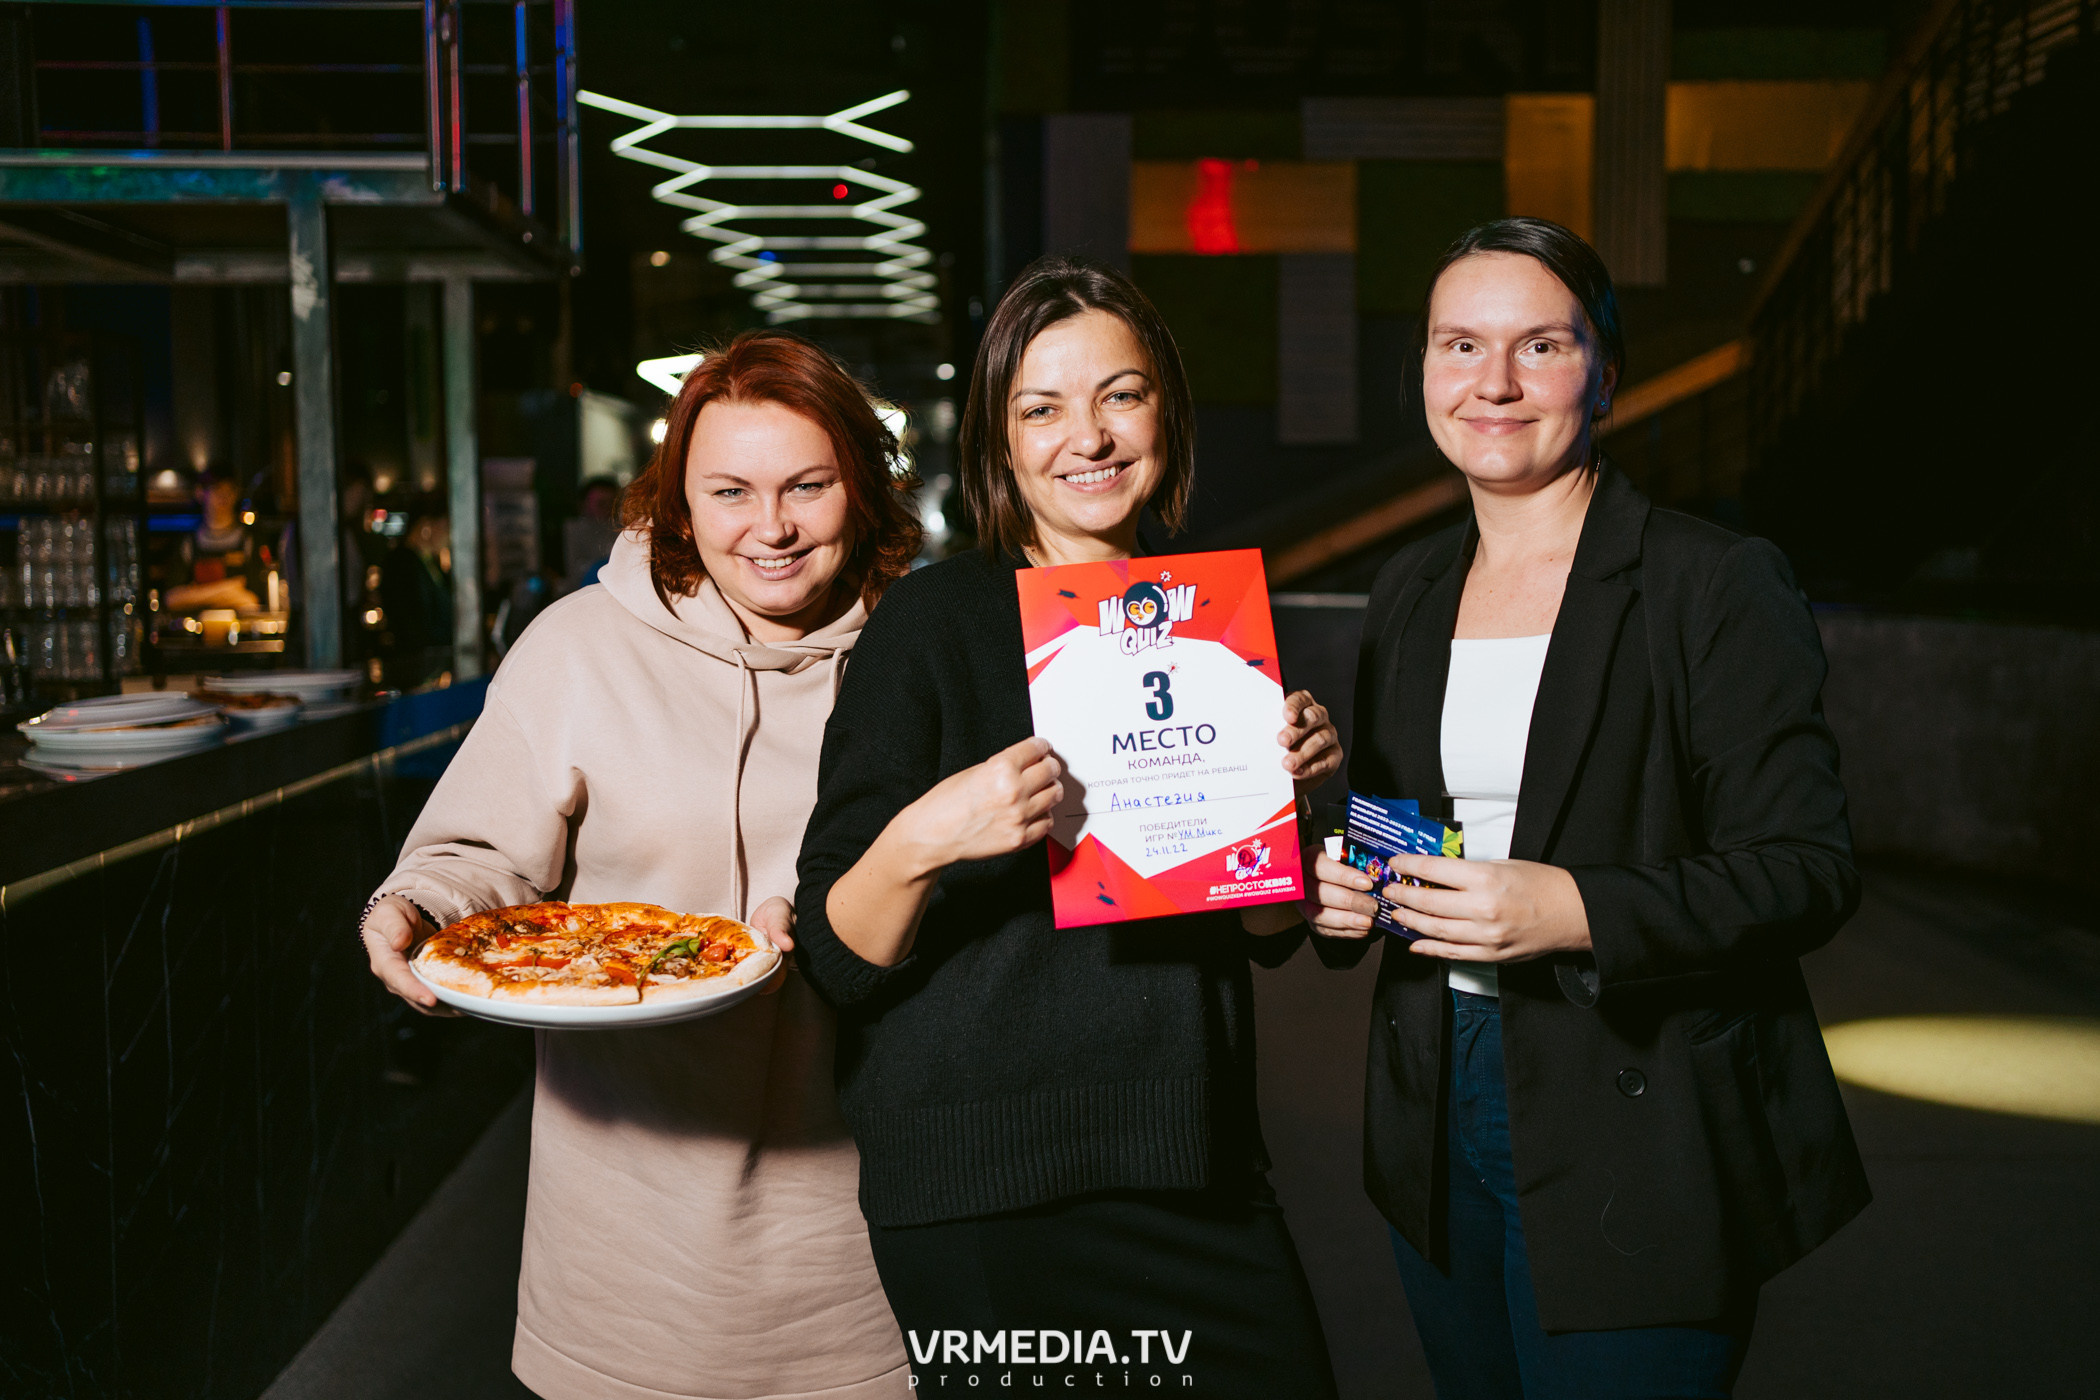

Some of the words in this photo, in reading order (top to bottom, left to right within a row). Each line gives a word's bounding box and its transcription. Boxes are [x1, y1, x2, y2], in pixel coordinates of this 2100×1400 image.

[1098, 582, 1198, 636] WOW
[1120, 620, 1174, 656] QUIZ
[1142, 670, 1174, 721] 3
[1112, 723, 1216, 754] МЕСТО
[1087, 777, 1129, 789] КОТОРАЯ
[1130, 773, 1160, 784] ТОЧНО
[1161, 770, 1196, 781] ПРИДЕТ
[1197, 767, 1210, 776] НА
[1211, 764, 1249, 774] РЕВАНШ
[1139, 817, 1208, 832] ПОБЕДИТЕЛИ
[1145, 833, 1164, 842] ИГР
[1209, 877, 1293, 895] #НЕПРОСТОКВИЗ
